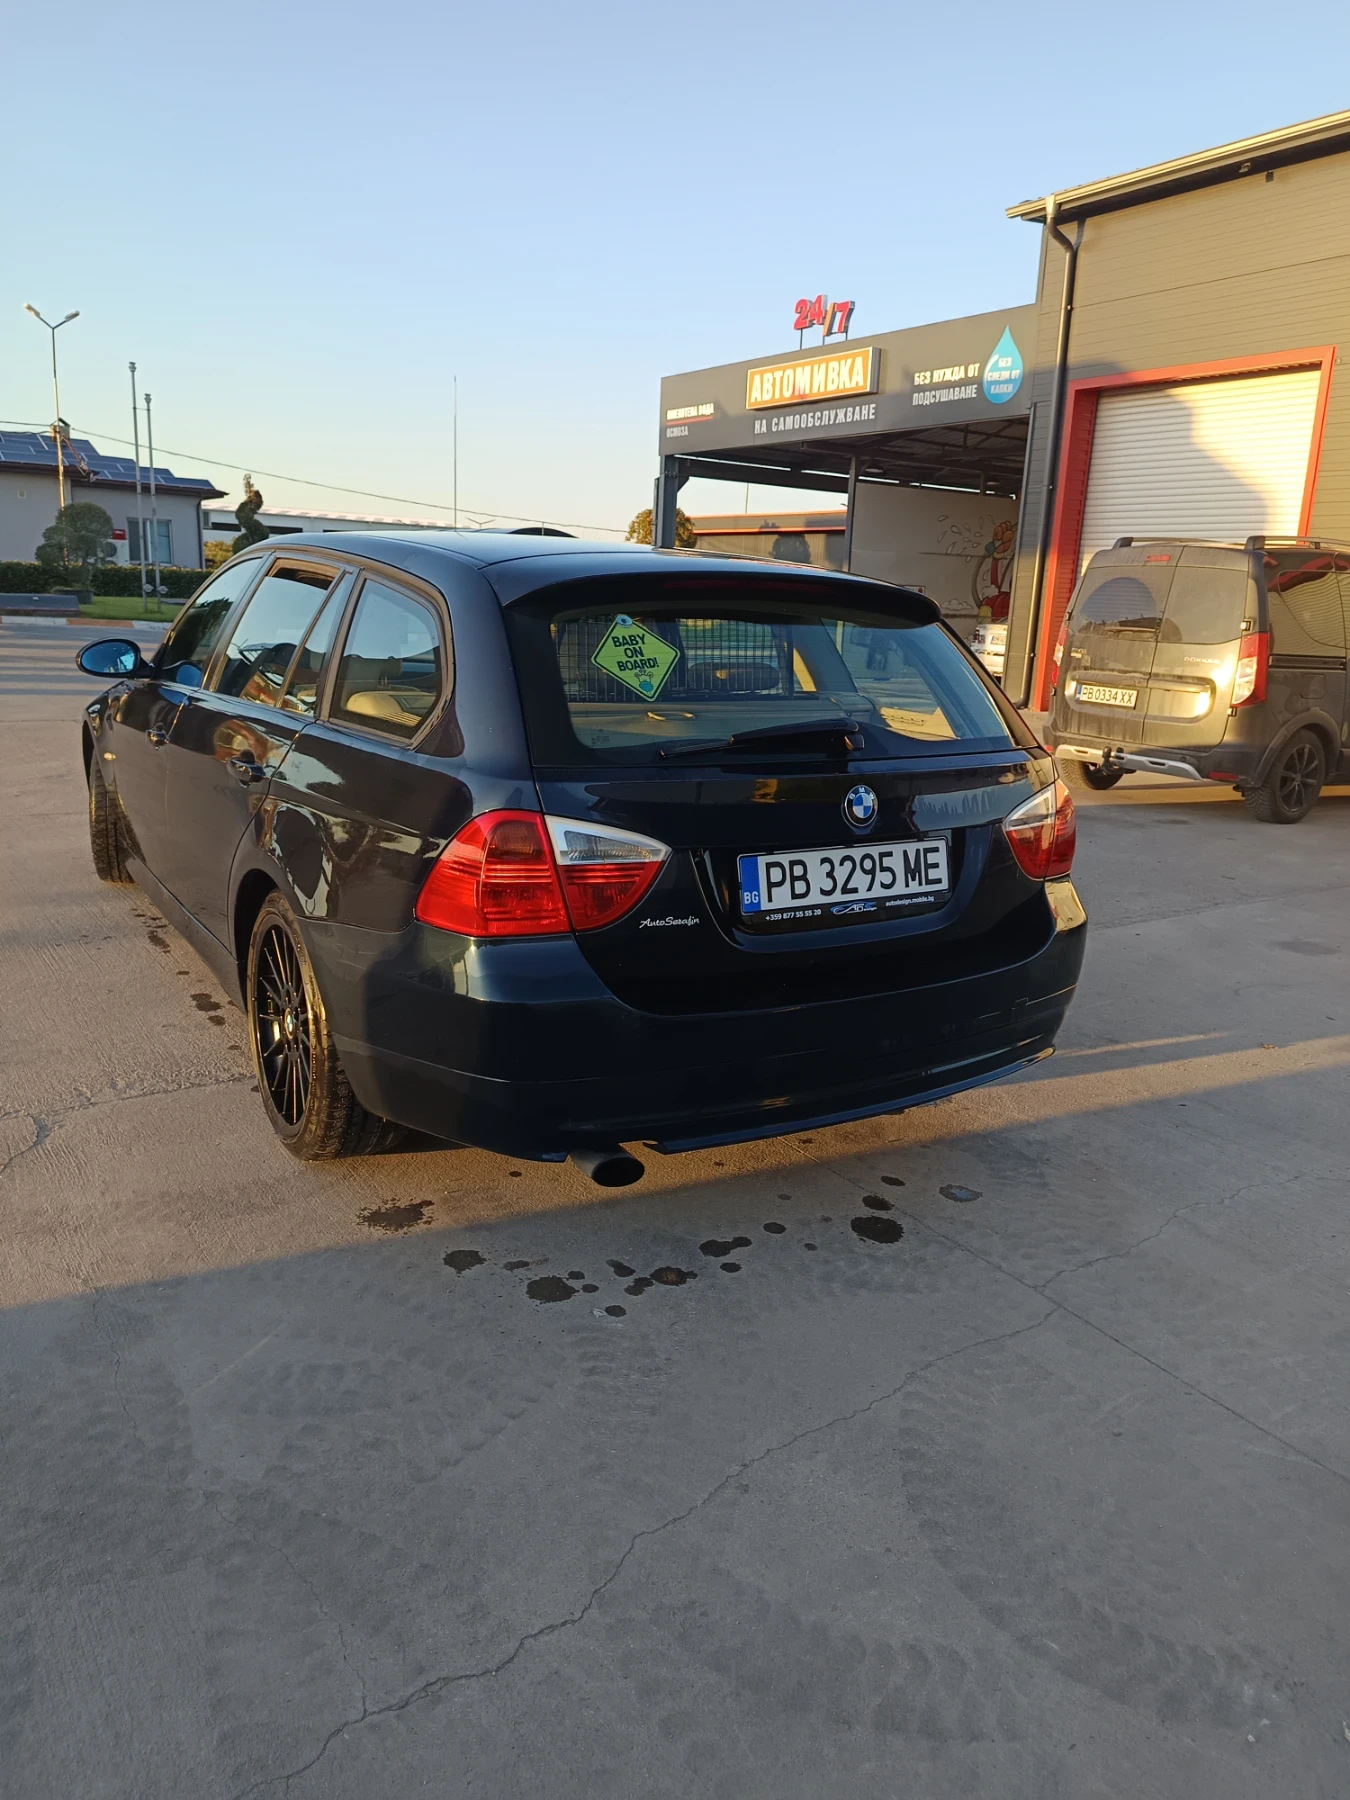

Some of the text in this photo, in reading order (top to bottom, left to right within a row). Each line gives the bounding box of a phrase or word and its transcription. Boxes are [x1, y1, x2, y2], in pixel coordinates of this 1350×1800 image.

[793, 294, 855, 336] 24/7
[750, 356, 864, 403] АВТОМИВКА
[914, 363, 980, 385] БЕЗ НУЖДА ОТ
[912, 385, 978, 406] ПОДСУШАВАНЕ
[754, 404, 876, 434] НА САМООБСЛУЖВАНЕ
[611, 634, 645, 647] BABY
[624, 646, 645, 658] ON
[616, 657, 659, 671] BOARD!
[1081, 687, 1134, 705] PB 0334 XX
[848, 787, 875, 800] BMW
[765, 846, 943, 903] PB 3295 ME
[743, 891, 759, 904] BG
[783, 911, 794, 919] 877
